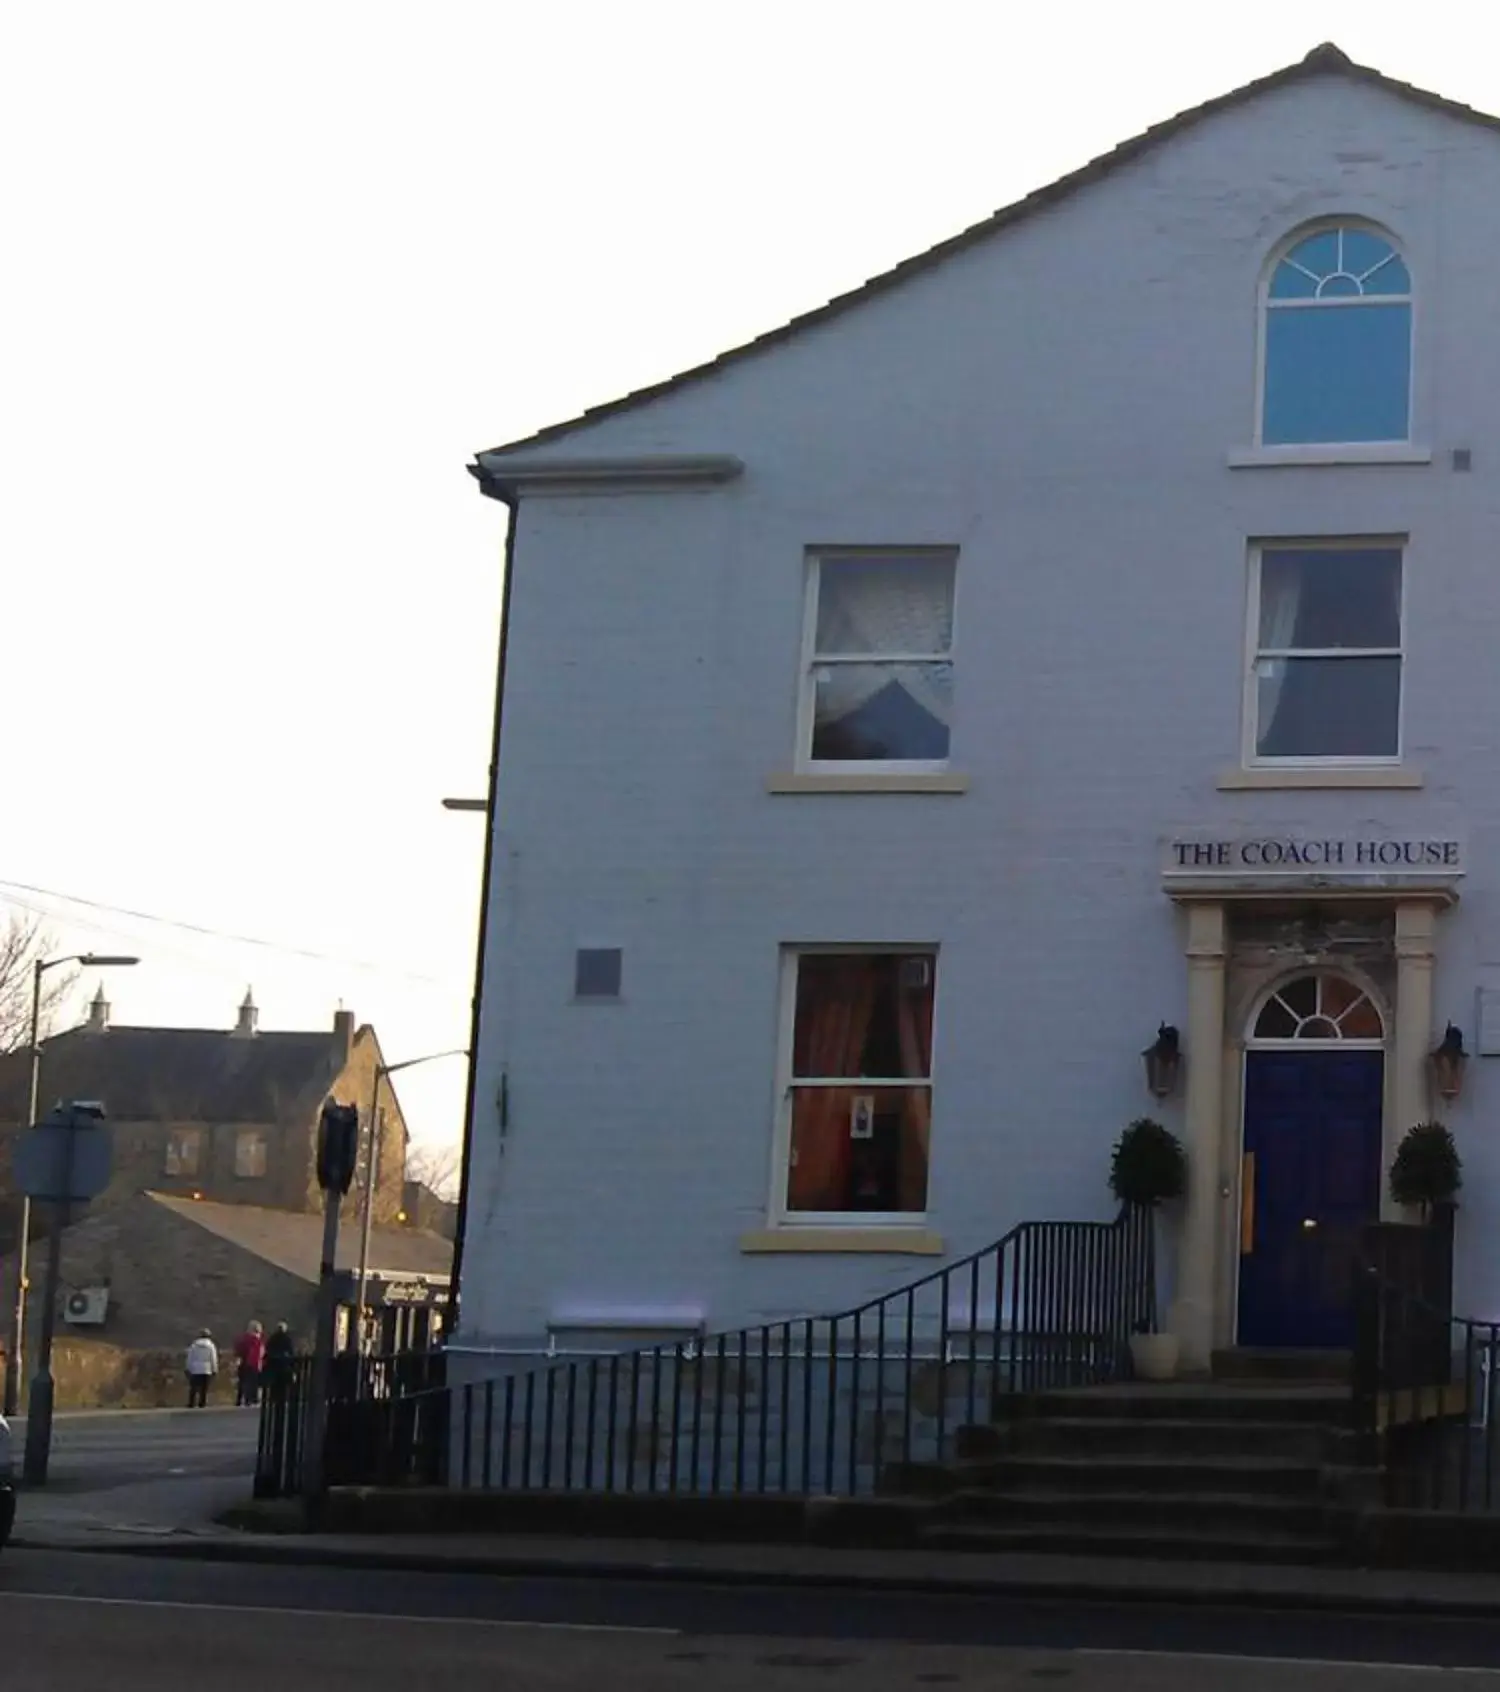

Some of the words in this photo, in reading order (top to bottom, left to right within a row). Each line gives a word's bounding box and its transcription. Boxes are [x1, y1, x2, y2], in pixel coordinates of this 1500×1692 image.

[1172, 842, 1231, 866] THE
[1241, 841, 1344, 865] COACH
[1356, 841, 1460, 865] HOUSE
